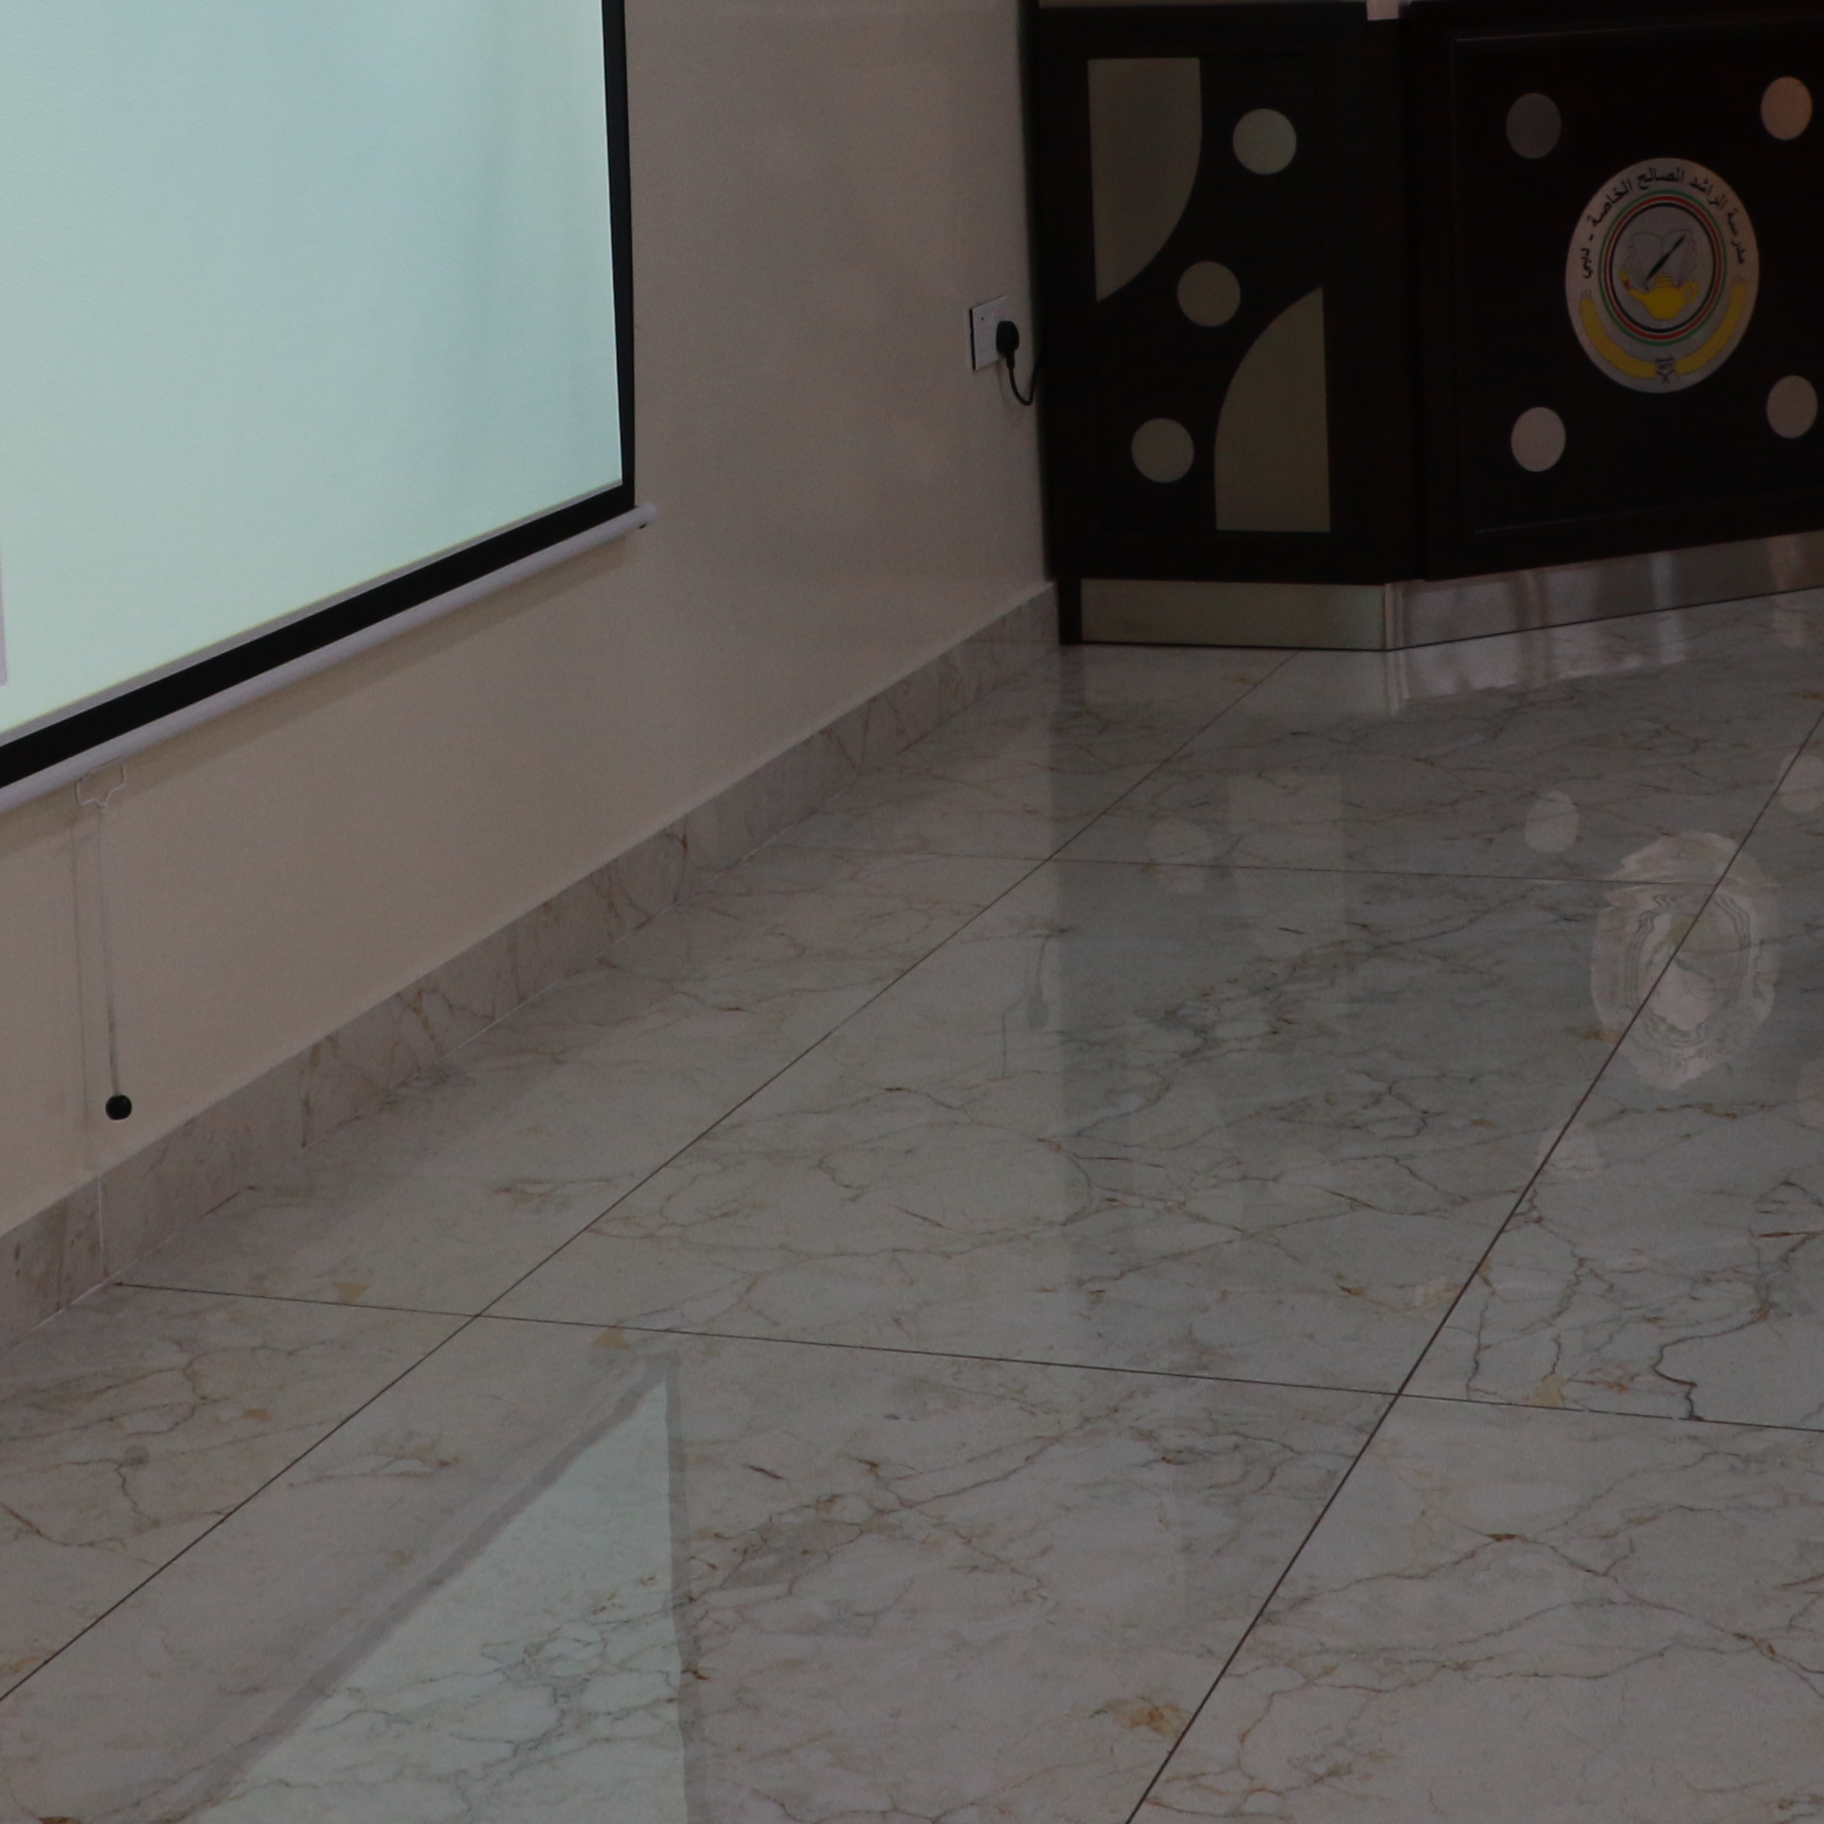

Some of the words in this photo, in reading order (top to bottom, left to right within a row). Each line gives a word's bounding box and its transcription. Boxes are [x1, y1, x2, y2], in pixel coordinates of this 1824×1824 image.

[1637, 167, 1685, 191] الصالح
[1689, 177, 1728, 209] الراشد
[1587, 180, 1633, 227] الخاصة
[1727, 208, 1747, 265] مدرسة
